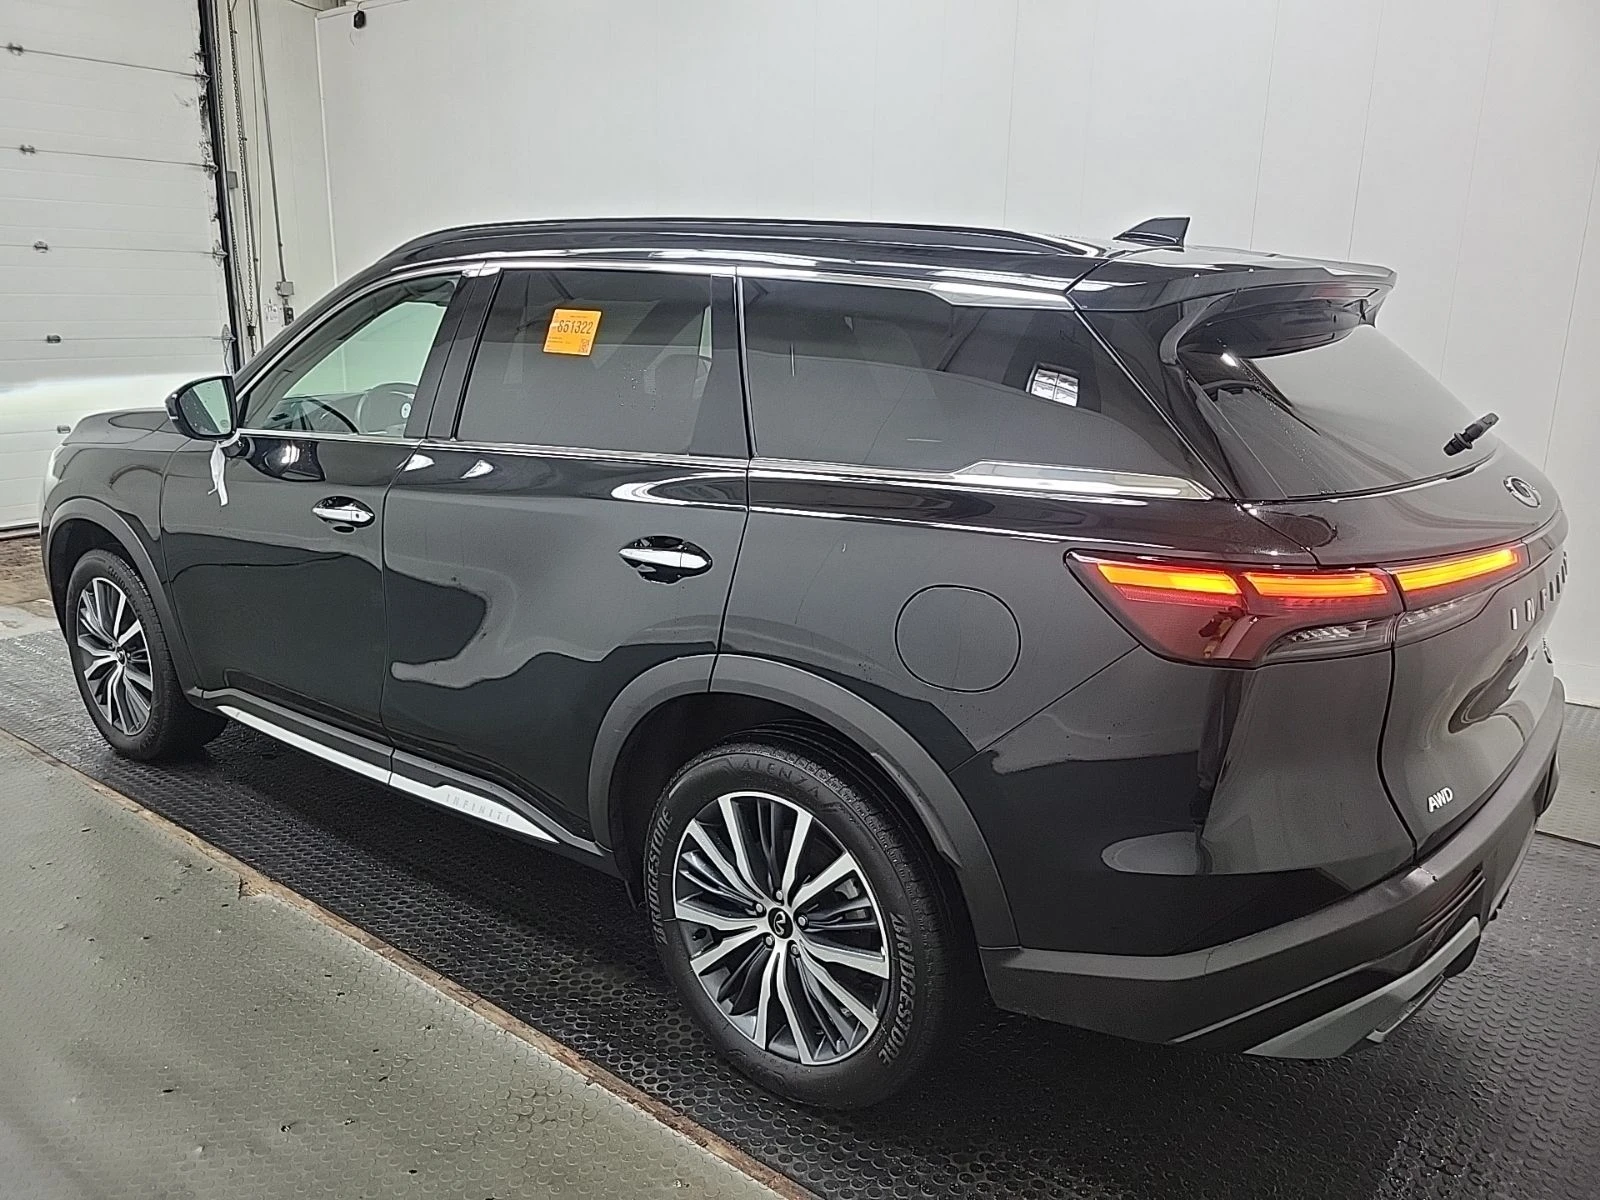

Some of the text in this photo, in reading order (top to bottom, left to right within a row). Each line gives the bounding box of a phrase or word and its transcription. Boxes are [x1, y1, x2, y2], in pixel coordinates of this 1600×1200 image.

[446, 793, 511, 823] INFINITI
[1427, 787, 1454, 813] AWD
[648, 806, 673, 945] BRIDGESTONE
[877, 911, 917, 1068] BRIDGESTONE
